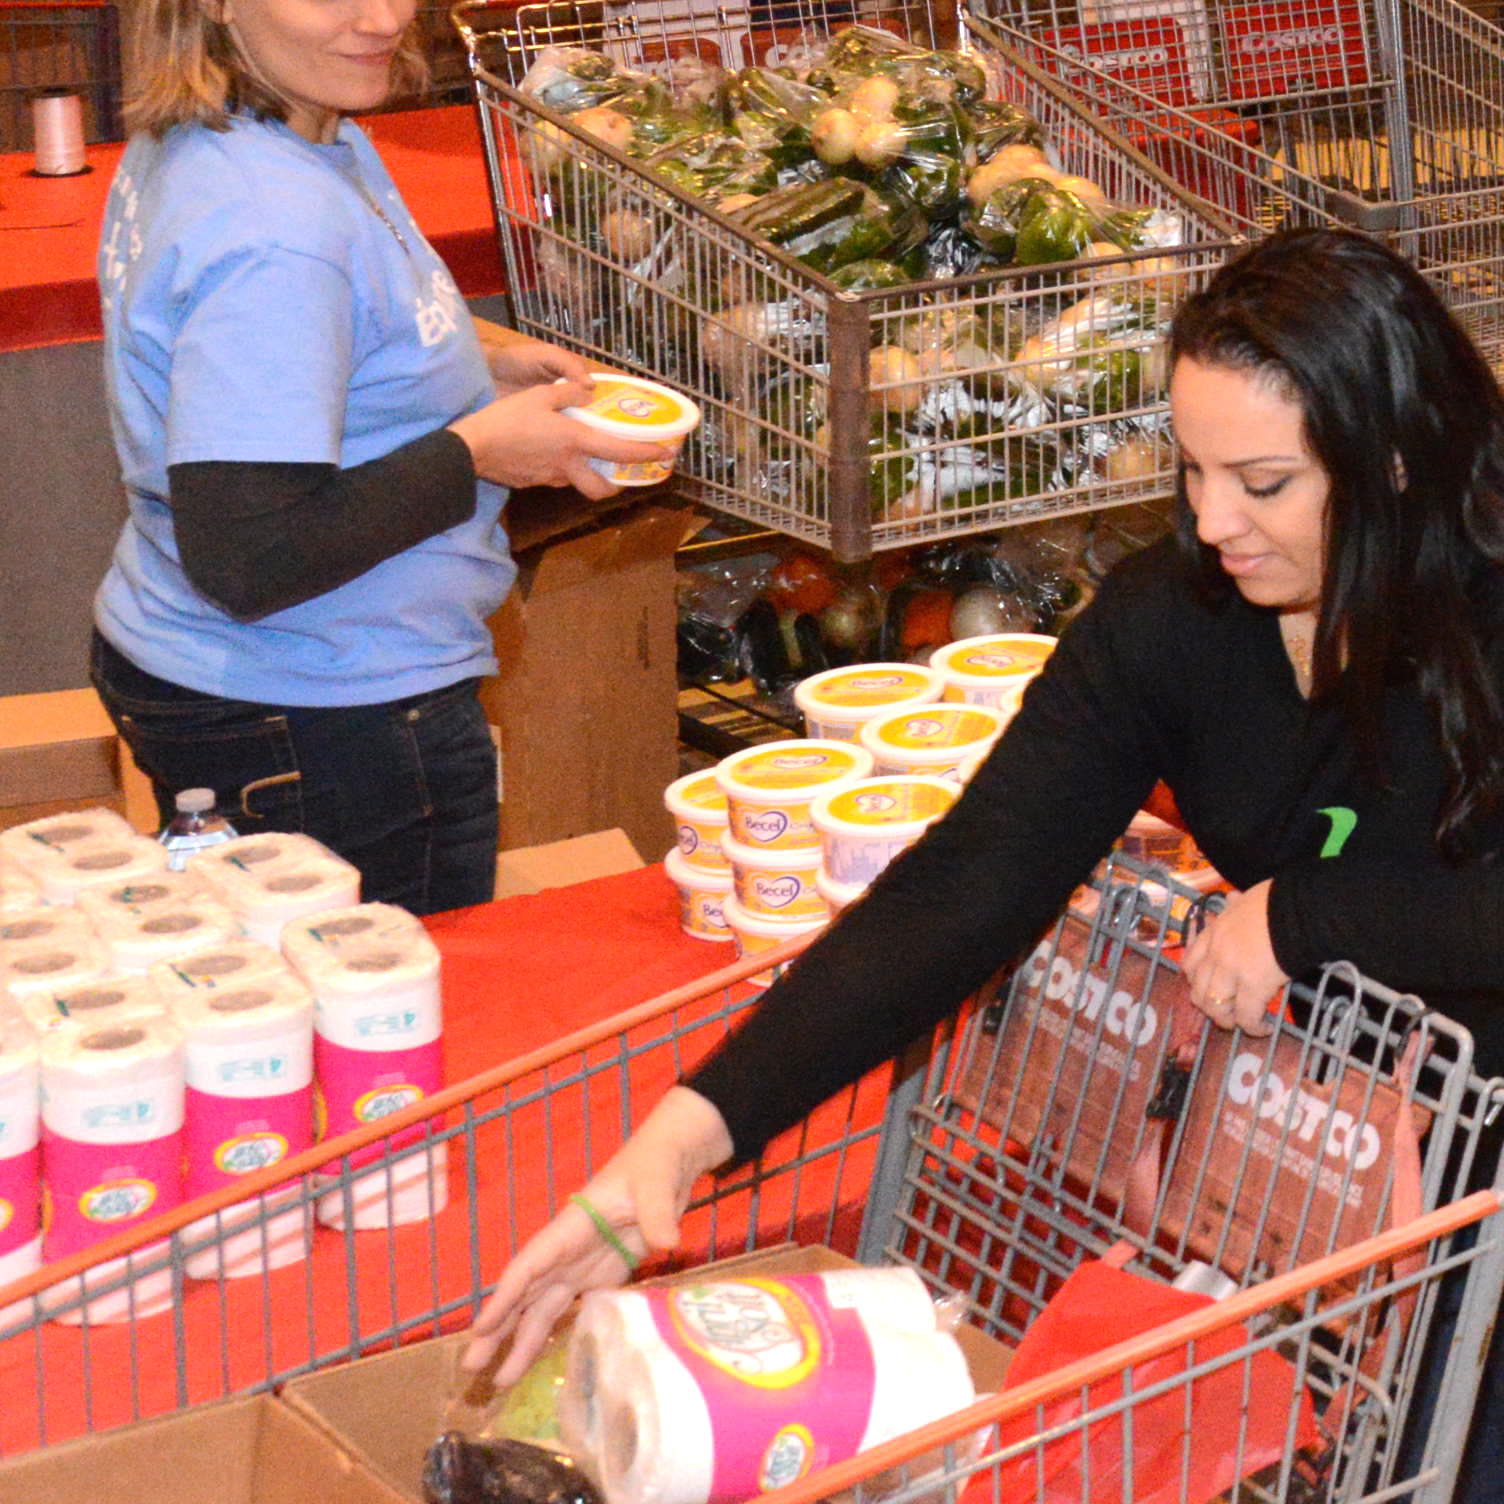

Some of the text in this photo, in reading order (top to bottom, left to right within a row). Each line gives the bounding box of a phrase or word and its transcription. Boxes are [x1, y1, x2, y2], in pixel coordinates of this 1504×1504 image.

[746, 816, 783, 833] Becel
[756, 882, 796, 897] Becel
[1027, 940, 1158, 1047] COSTCO
[1227, 1052, 1380, 1171] COSTCO
